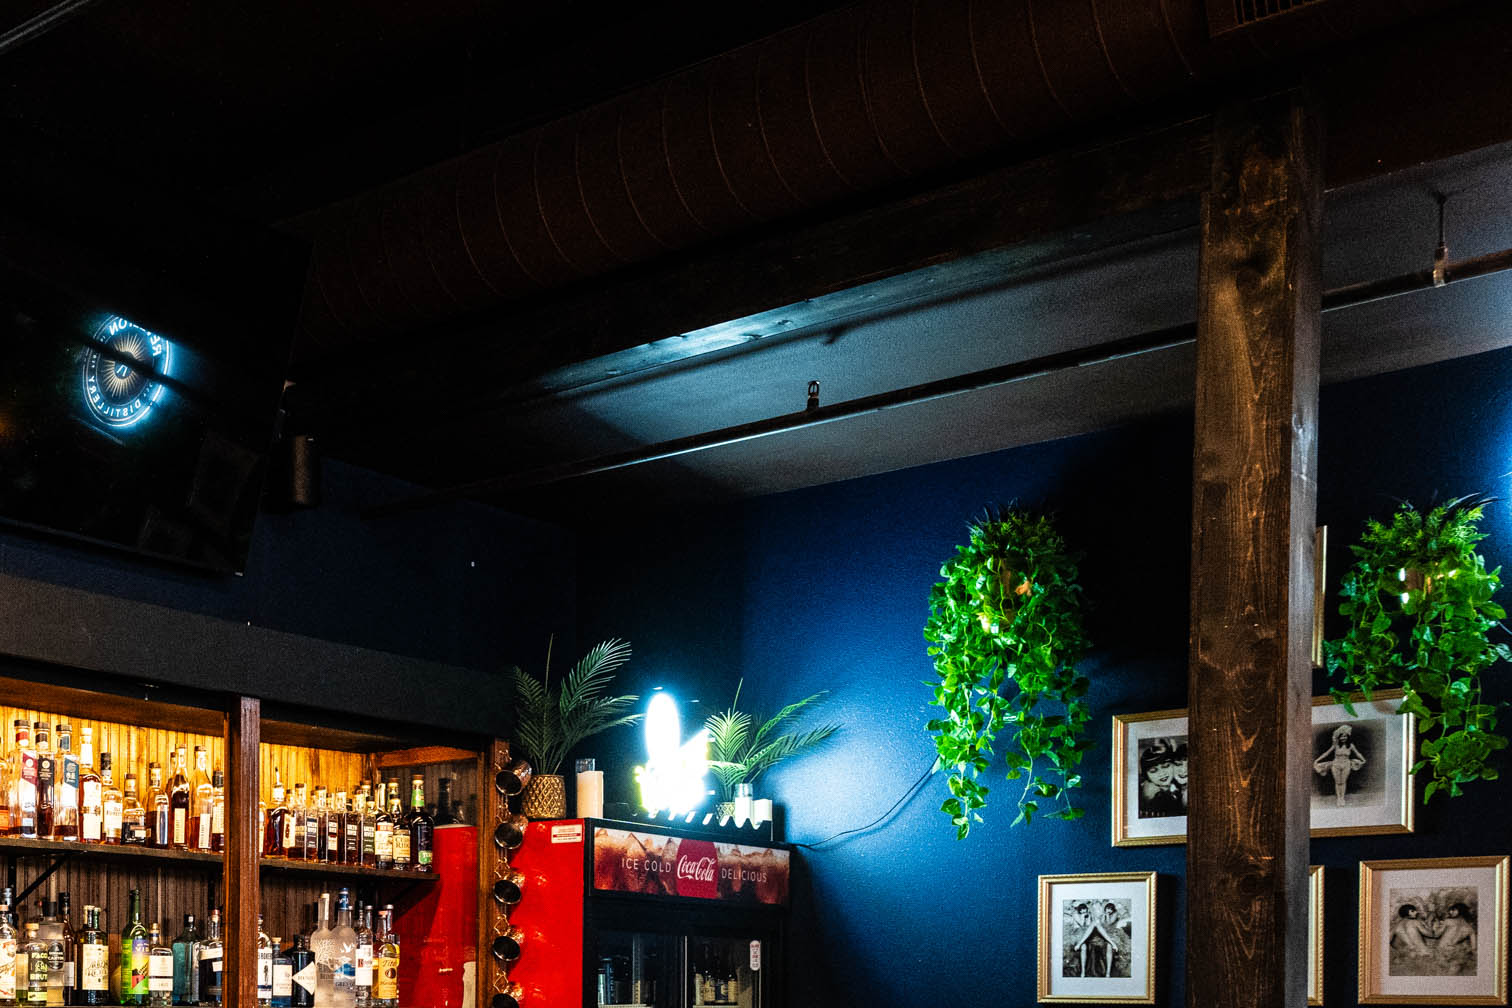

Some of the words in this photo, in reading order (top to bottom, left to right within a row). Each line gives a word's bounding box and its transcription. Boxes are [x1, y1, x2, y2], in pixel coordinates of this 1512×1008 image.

[621, 857, 638, 870] ICE
[643, 859, 672, 873] COLD
[677, 854, 717, 882] Coca-Cola
[721, 867, 768, 883] DELICIOUS
